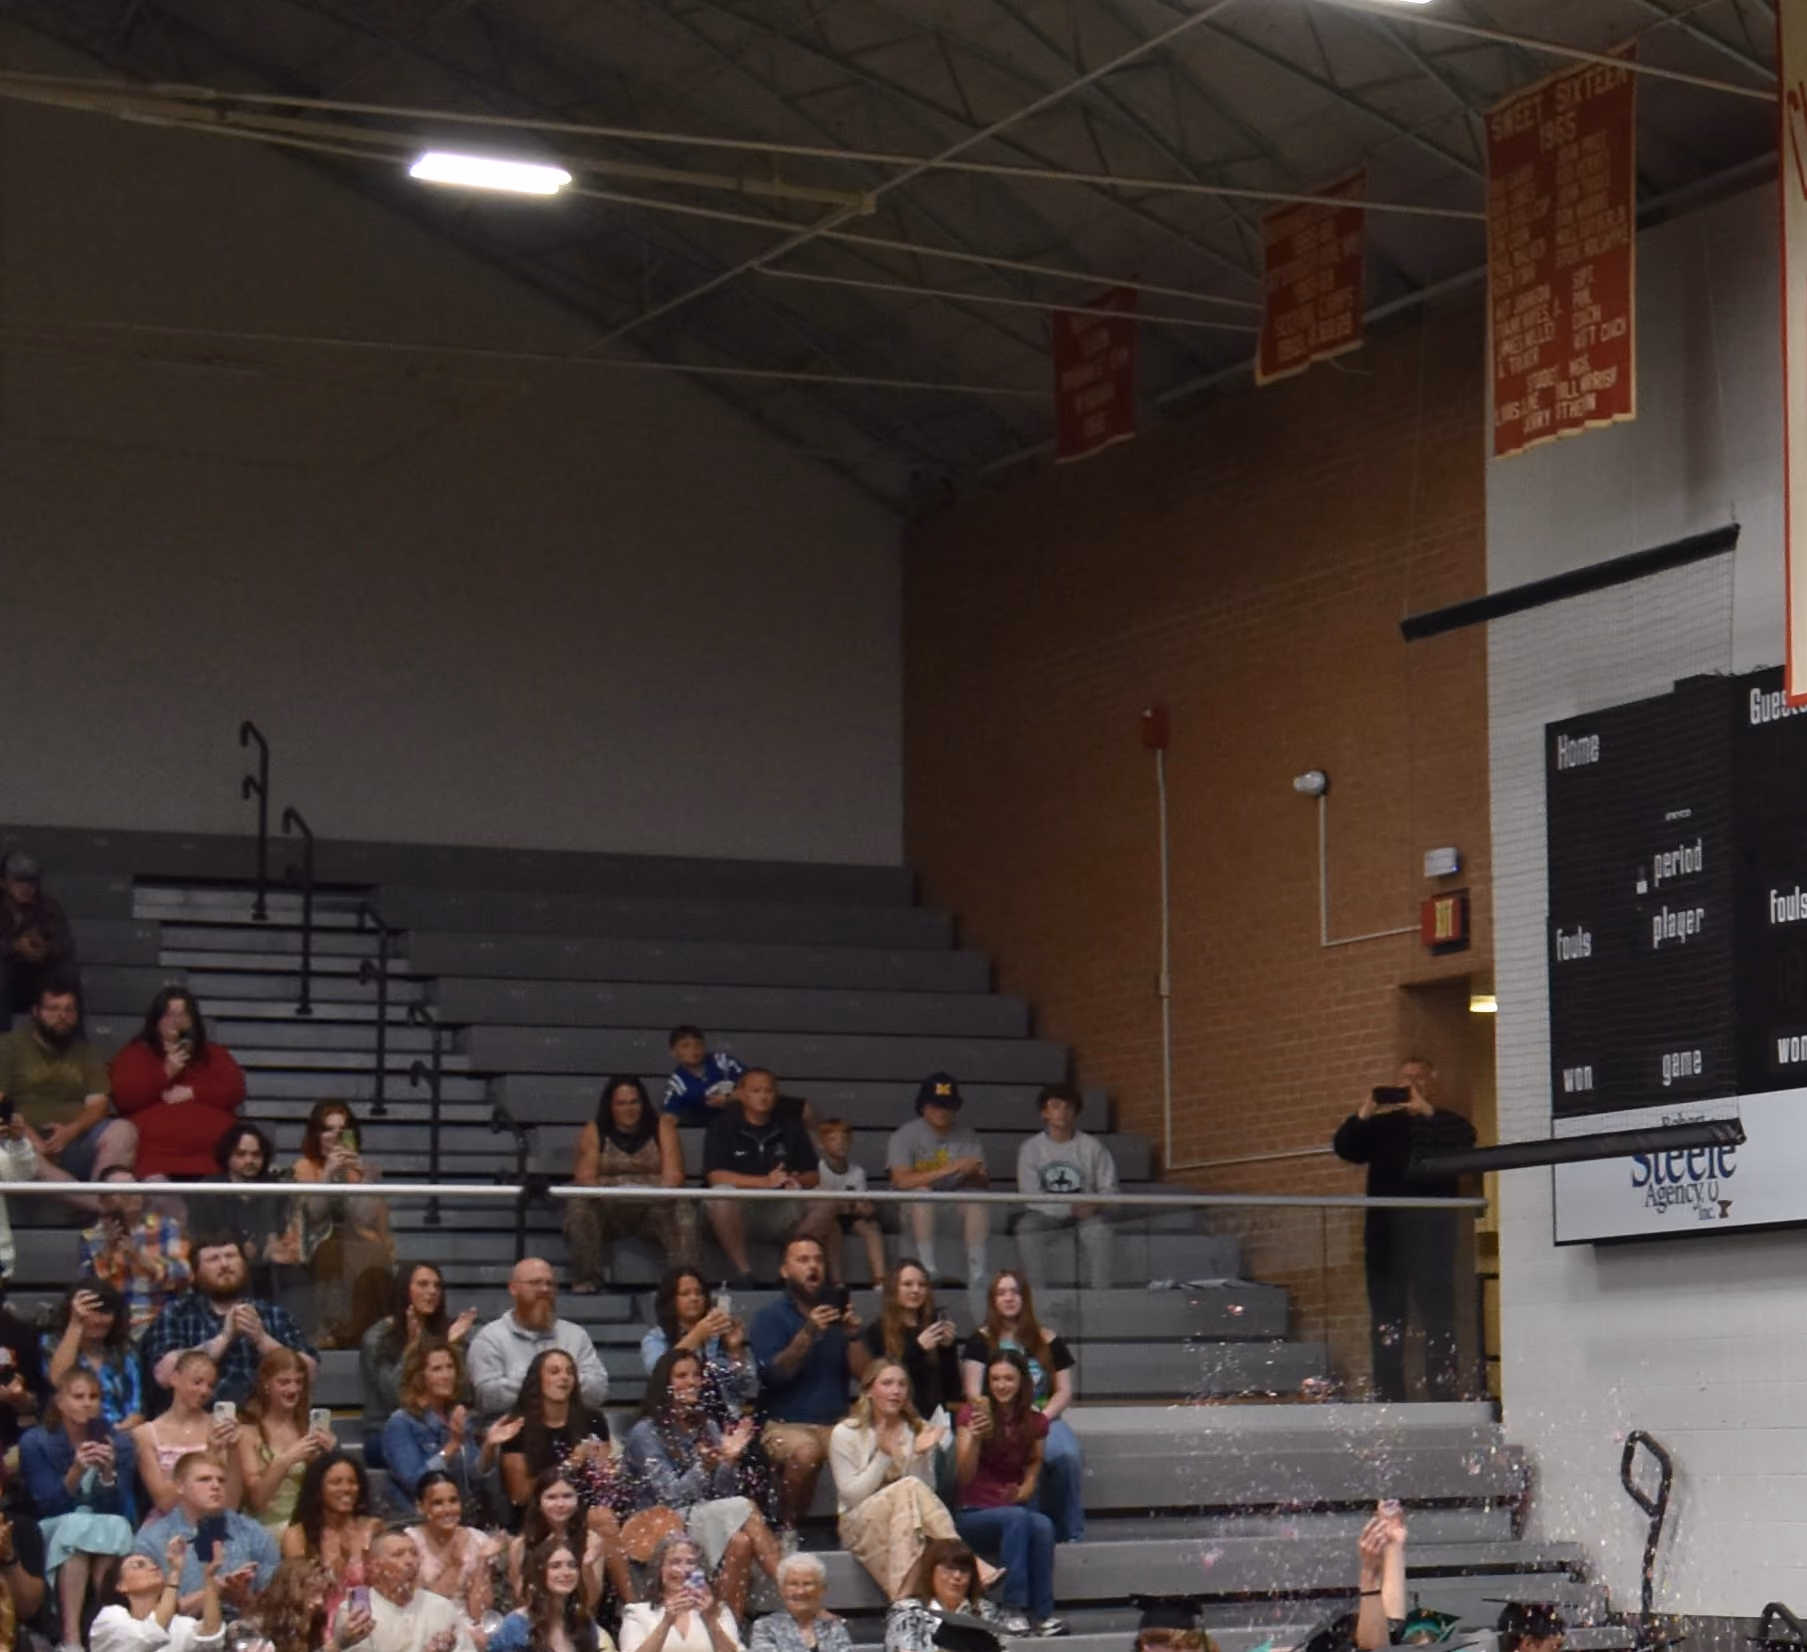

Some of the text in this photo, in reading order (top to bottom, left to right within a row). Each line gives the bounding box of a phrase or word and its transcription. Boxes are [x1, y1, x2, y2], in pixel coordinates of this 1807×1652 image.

[1557, 733, 1600, 770] Home
[1653, 837, 1703, 888] period
[1556, 924, 1592, 962] fouls
[1652, 905, 1705, 949] player
[1661, 1049, 1702, 1087] game
